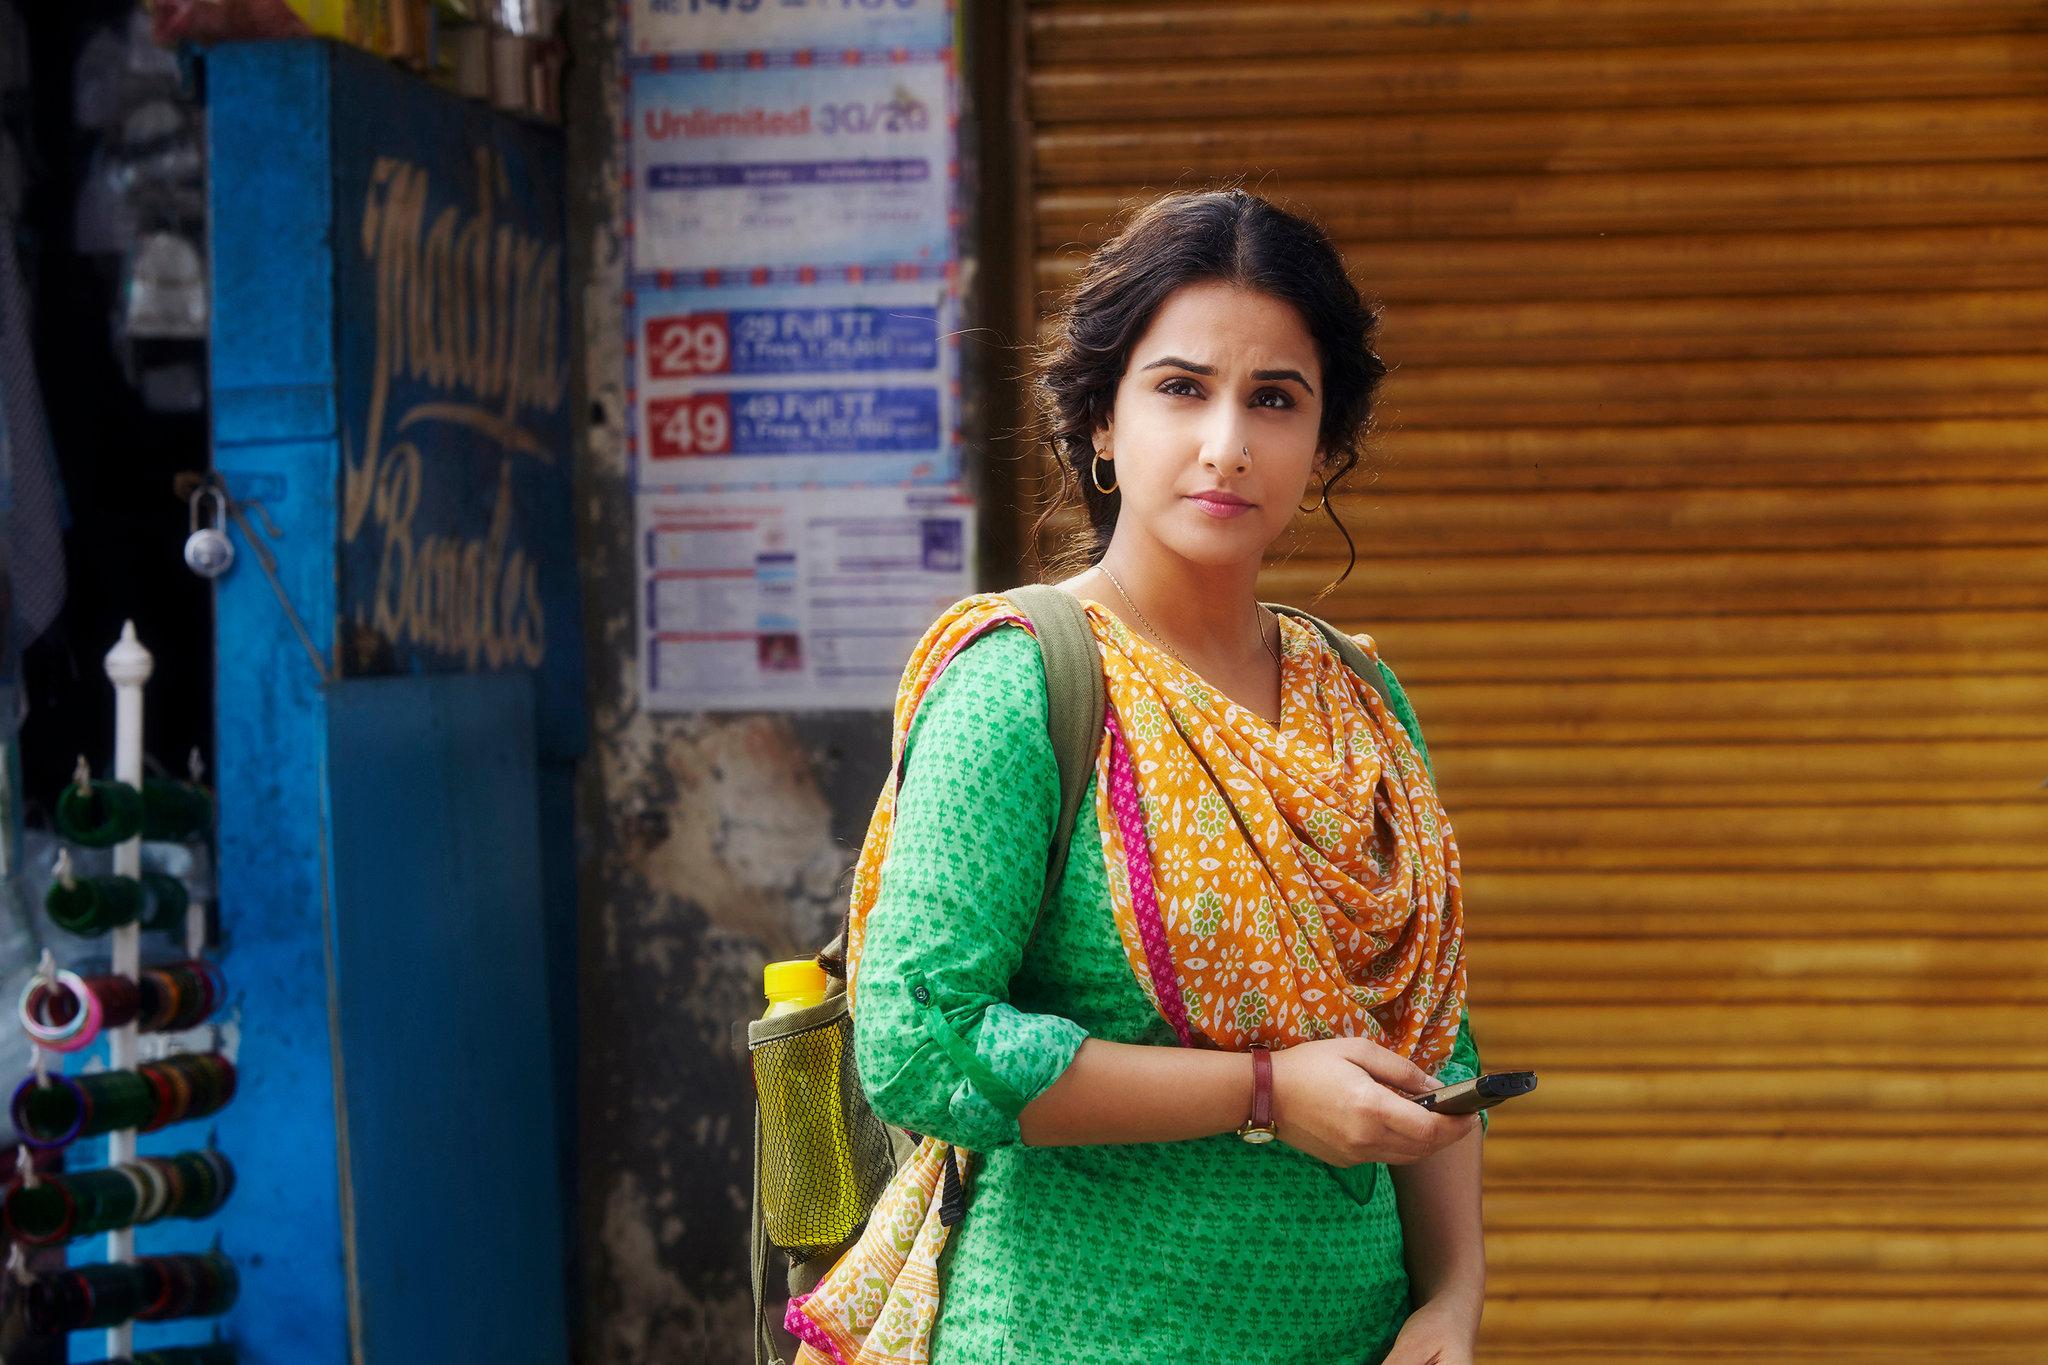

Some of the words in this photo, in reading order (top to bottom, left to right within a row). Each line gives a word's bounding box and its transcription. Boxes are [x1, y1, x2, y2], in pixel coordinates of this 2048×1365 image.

[644, 106, 811, 142] Unlimited
[661, 323, 729, 372] 29
[661, 404, 730, 451] 49
[373, 442, 546, 669] Bangles
